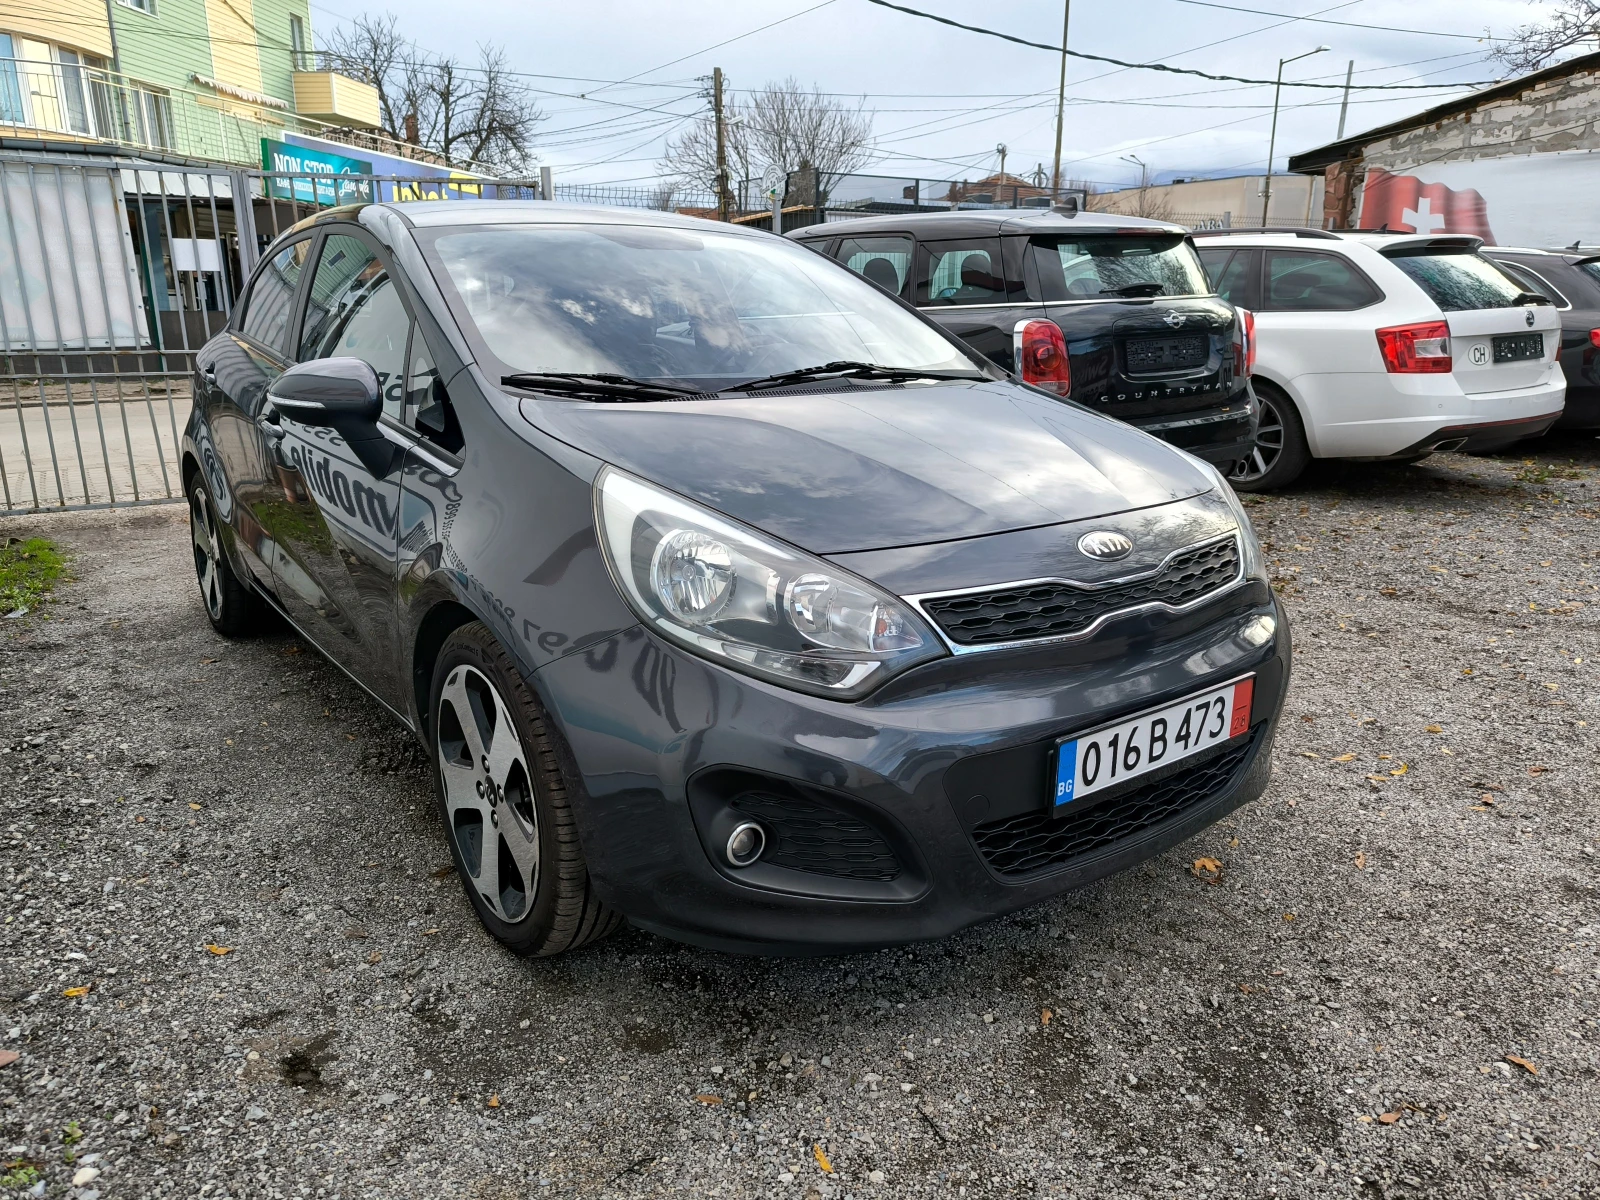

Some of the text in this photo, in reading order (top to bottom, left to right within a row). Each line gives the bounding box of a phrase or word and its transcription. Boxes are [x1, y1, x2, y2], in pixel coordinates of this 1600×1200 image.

[274, 153, 334, 184] NON STOP
[1473, 347, 1486, 362] CH
[1101, 381, 1232, 402] COUNTRYMAN
[1088, 535, 1131, 556] KIA
[1232, 714, 1246, 730] 28
[1081, 696, 1226, 787] 016B473
[1057, 780, 1073, 796] BG
